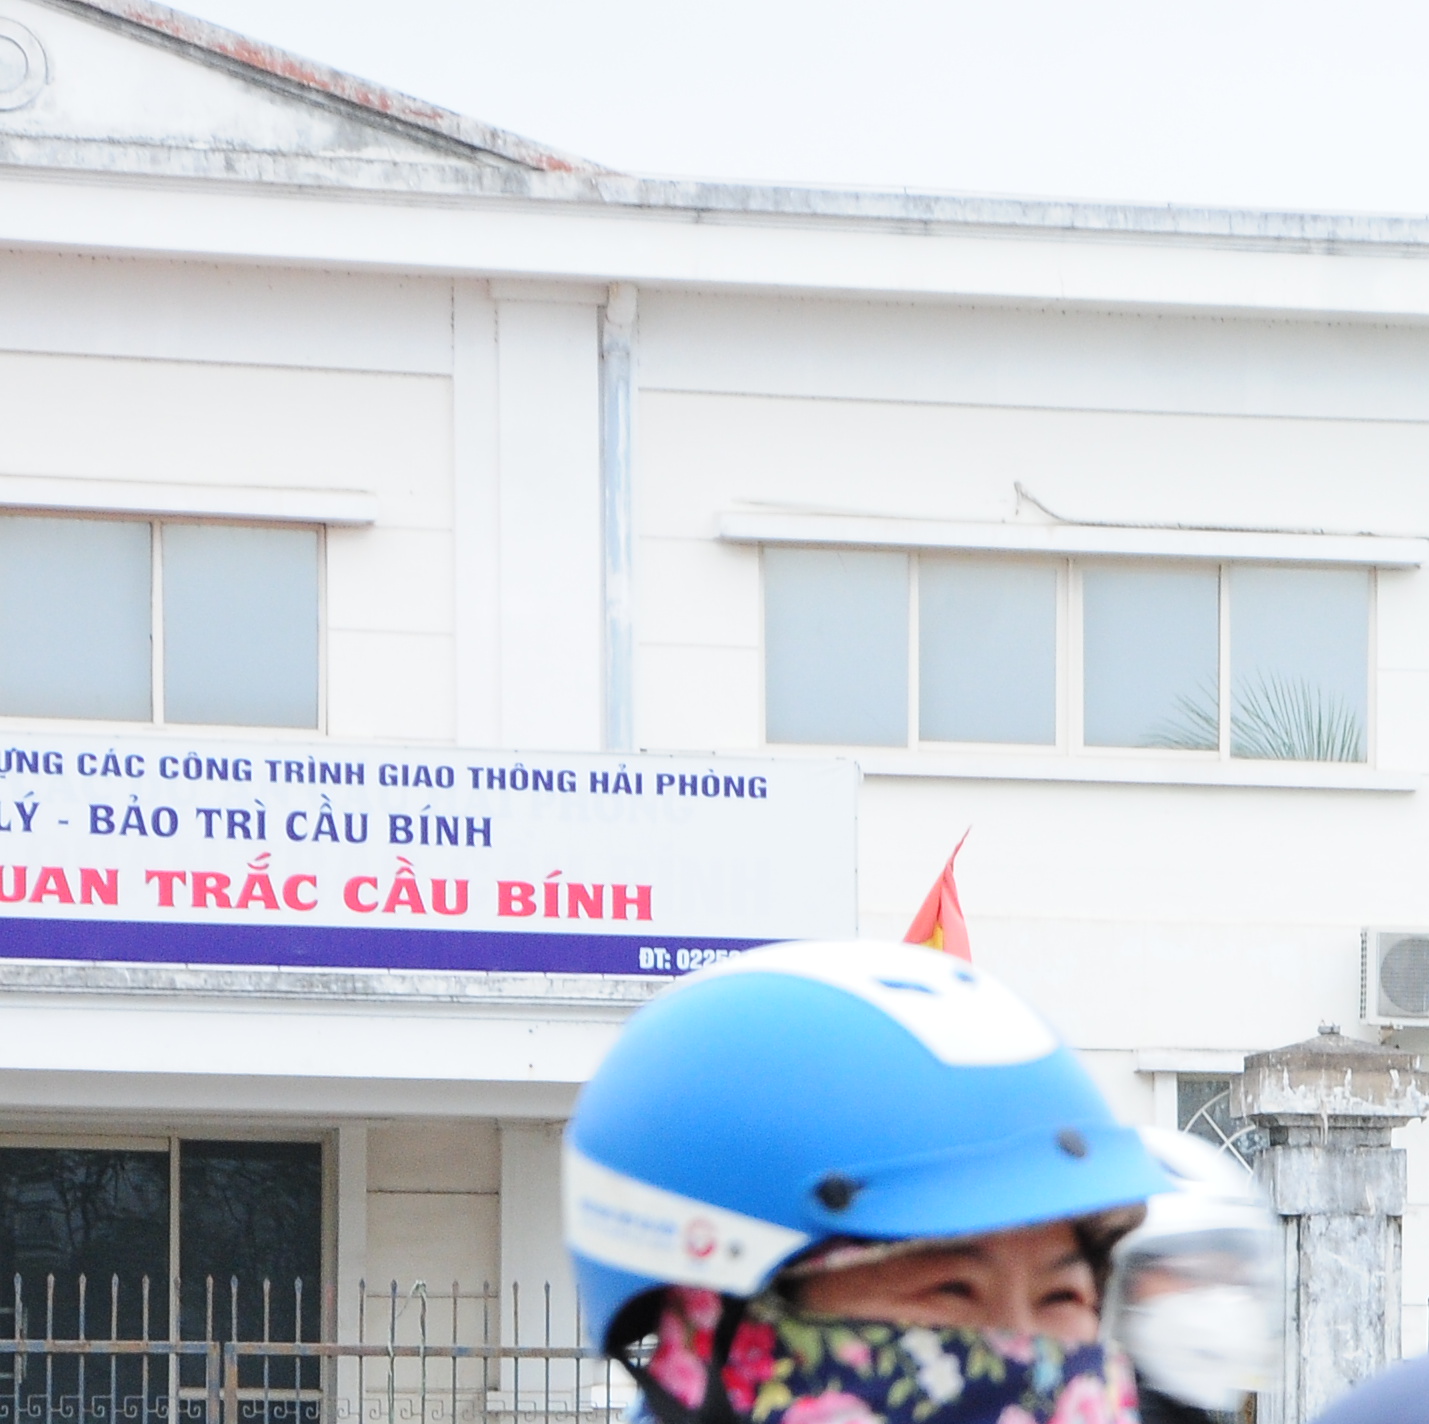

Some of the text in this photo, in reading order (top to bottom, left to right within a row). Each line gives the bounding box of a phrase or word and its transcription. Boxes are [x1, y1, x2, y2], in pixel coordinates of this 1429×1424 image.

[77, 748, 145, 779] CÁC
[159, 752, 252, 782] CÔNG
[265, 755, 365, 787] TRÌNH
[378, 763, 455, 790] GIAO
[467, 762, 577, 793] THÔNG
[590, 763, 643, 795] HẢI
[656, 768, 768, 799] PHÒNG
[89, 794, 179, 838] BẢO
[196, 798, 267, 841] TRÌ
[285, 793, 368, 844] CẦU
[388, 804, 492, 848] BÍNH
[0, 851, 654, 922] UAN TRẮC CẦU BÍNH
[639, 947, 672, 969] ĐT:
